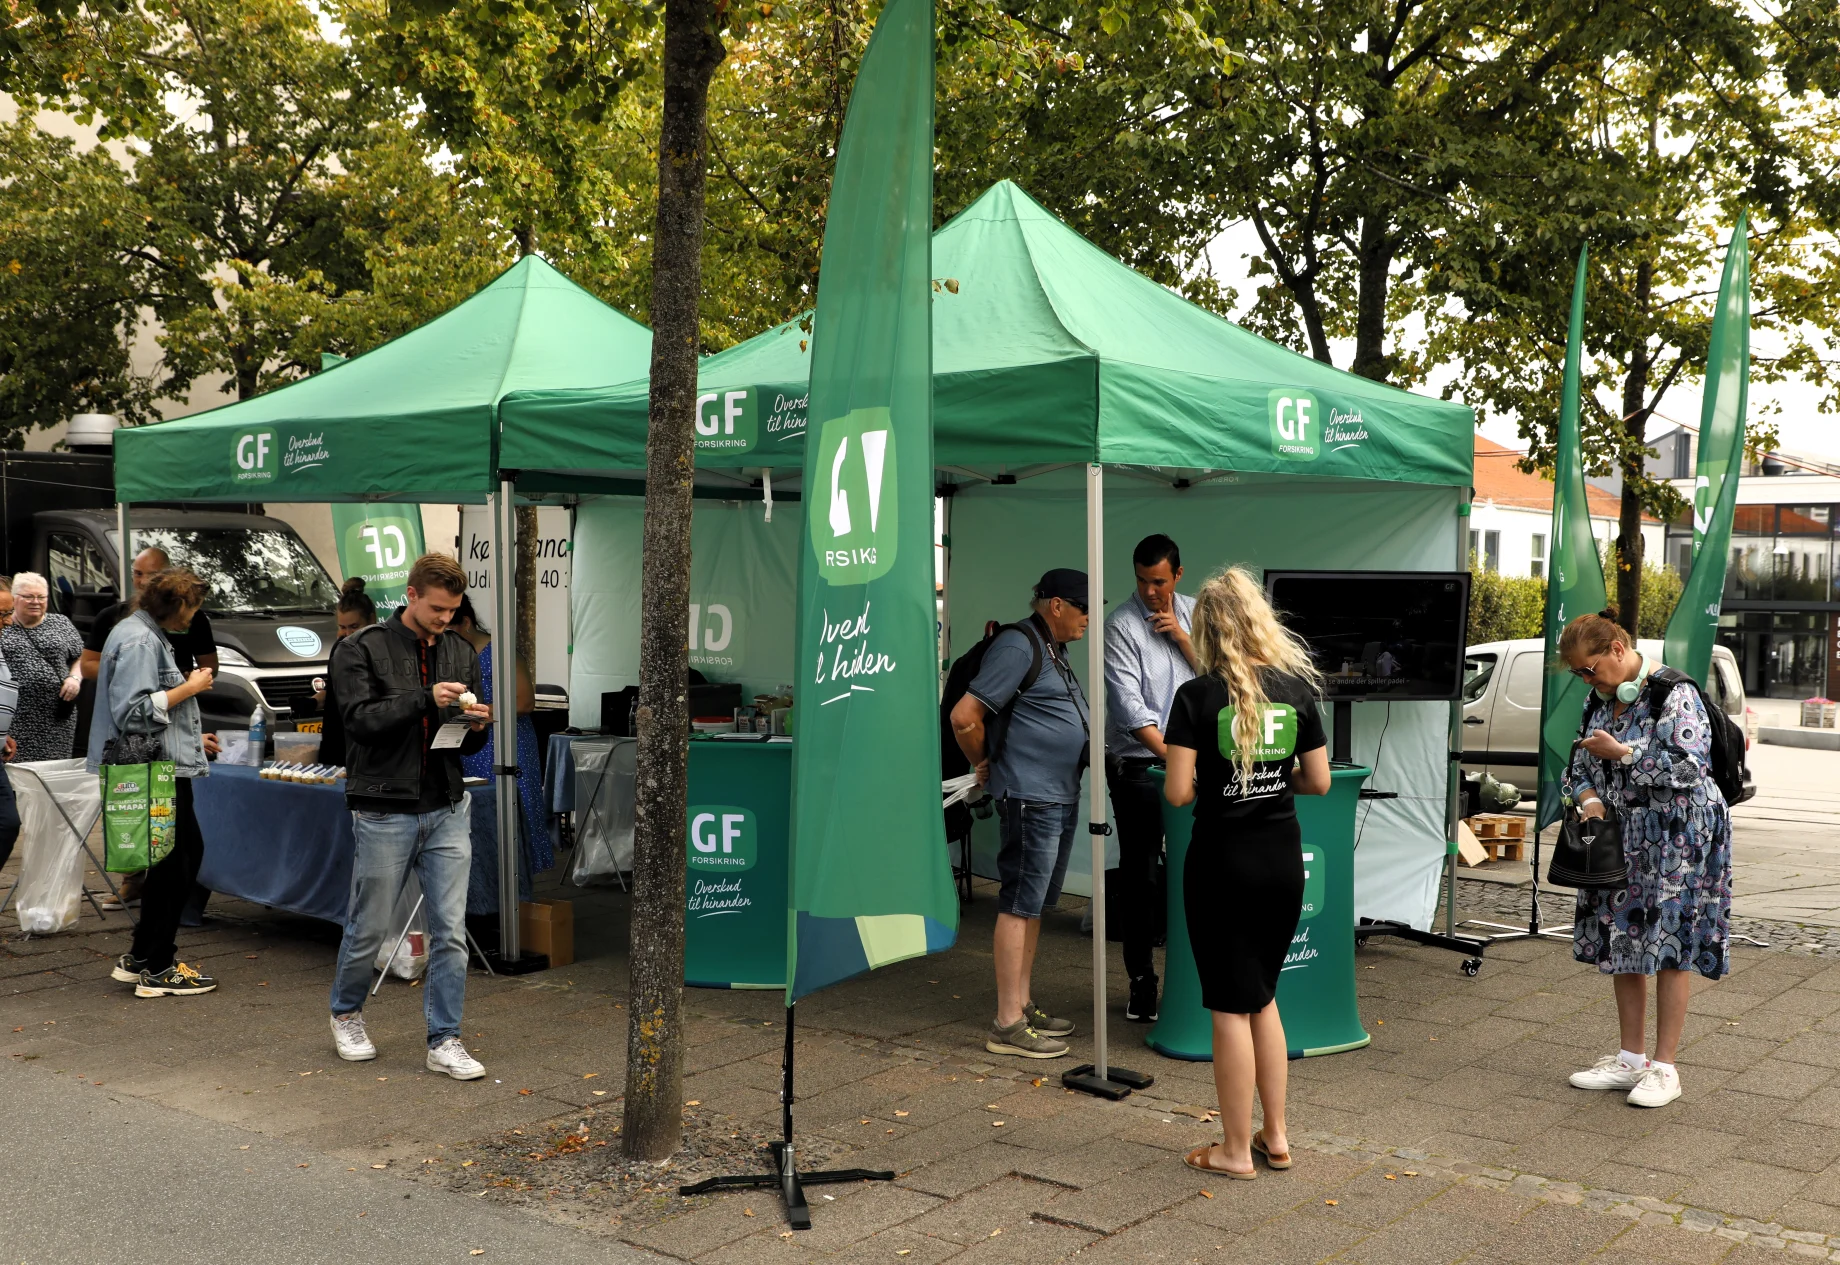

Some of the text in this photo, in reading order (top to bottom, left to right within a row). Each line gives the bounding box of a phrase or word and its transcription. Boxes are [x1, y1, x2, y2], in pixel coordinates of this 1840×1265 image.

[774, 393, 808, 413] Oversk
[696, 391, 747, 435] GF
[1276, 397, 1311, 441] GF
[1329, 408, 1363, 425] Overskud
[767, 412, 807, 432] til hina
[288, 432, 324, 451] Overskud
[1325, 425, 1368, 442] til hinanden
[237, 433, 271, 470] GF
[694, 439, 747, 448] FORSIKRING
[1279, 444, 1314, 454] FORSIKRING
[284, 447, 330, 466] til hinanden
[540, 569, 559, 588] 40
[1356, 677, 1366, 685] der
[1367, 677, 1386, 686] spiller
[1387, 677, 1405, 686] padel
[1230, 748, 1286, 756] FOSIKRING
[160, 764, 173, 773] YO
[1231, 765, 1282, 783] Oerskud
[1223, 783, 1238, 796] til
[106, 803, 147, 812] EL MAPA!
[691, 813, 745, 853] GF
[692, 856, 746, 866] FORSIKRING
[694, 878, 742, 895] Overskud
[688, 893, 751, 910] til hinanden
[1284, 944, 1319, 964] anden
